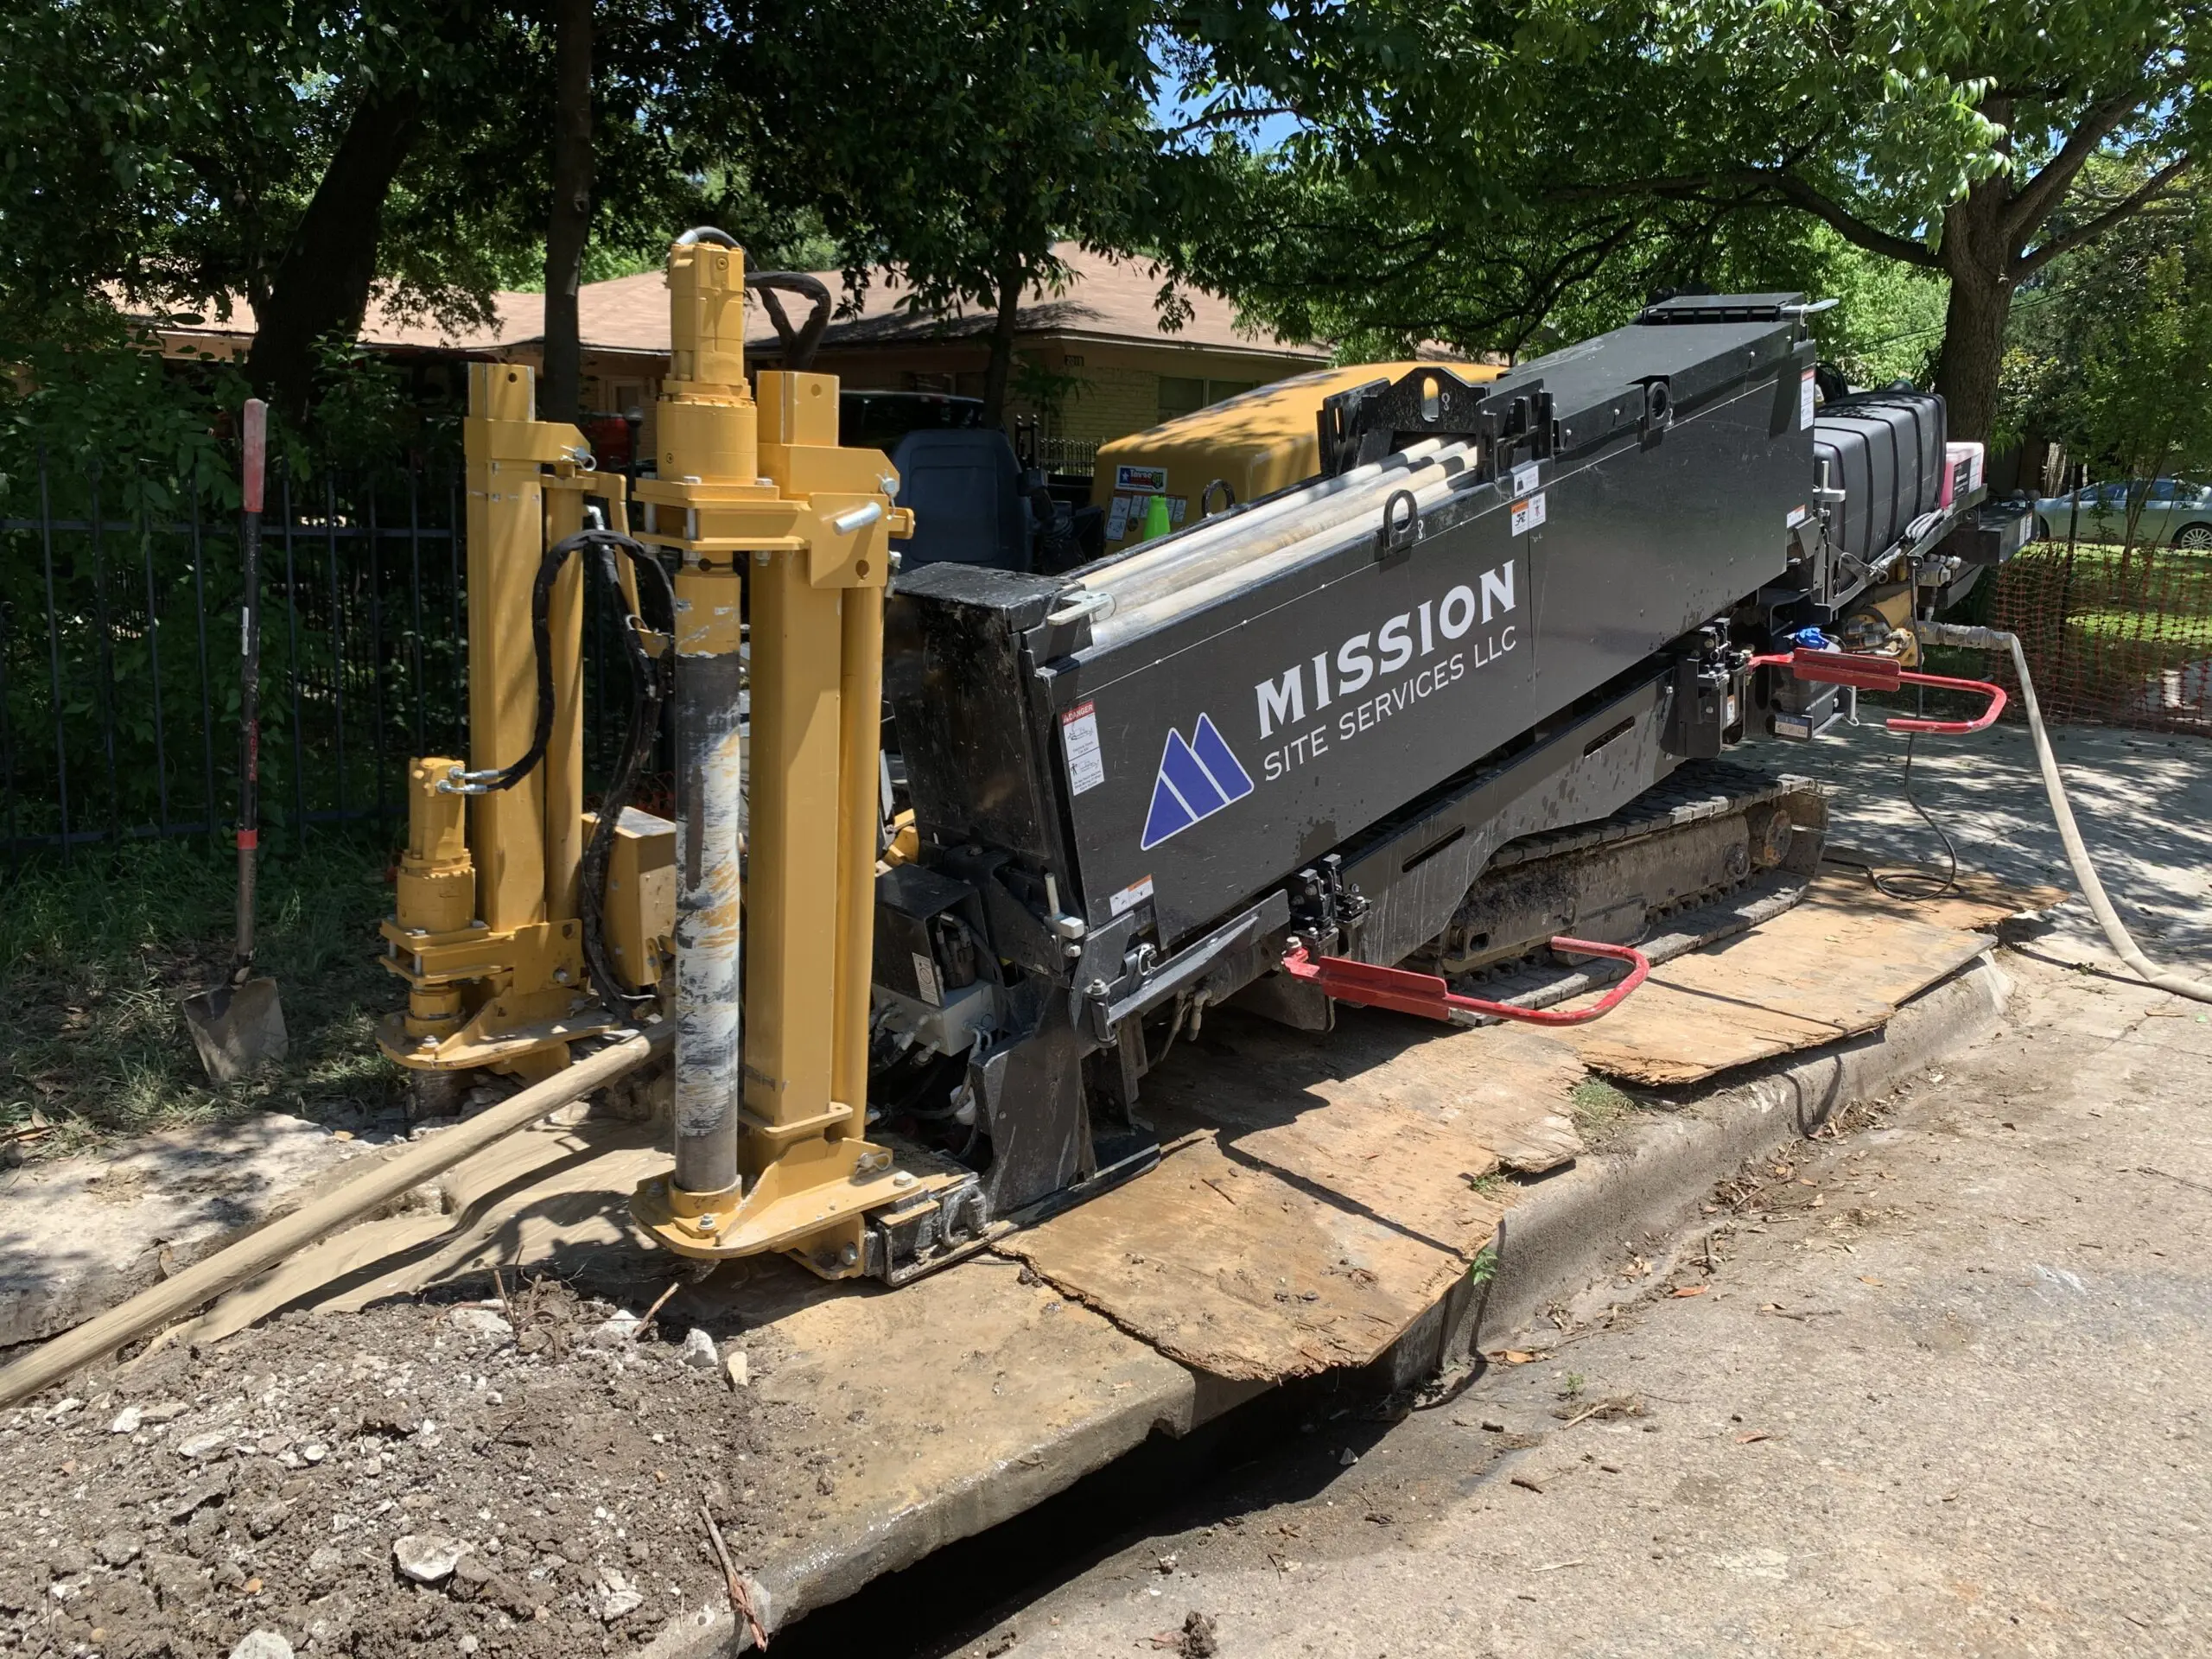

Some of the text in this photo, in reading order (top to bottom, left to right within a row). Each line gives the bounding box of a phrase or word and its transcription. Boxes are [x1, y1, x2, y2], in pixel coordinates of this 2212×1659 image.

[1068, 704, 1093, 721] DANGER
[1254, 559, 1516, 741] MISSION
[1263, 626, 1516, 781] SITE SERVICES LLC
